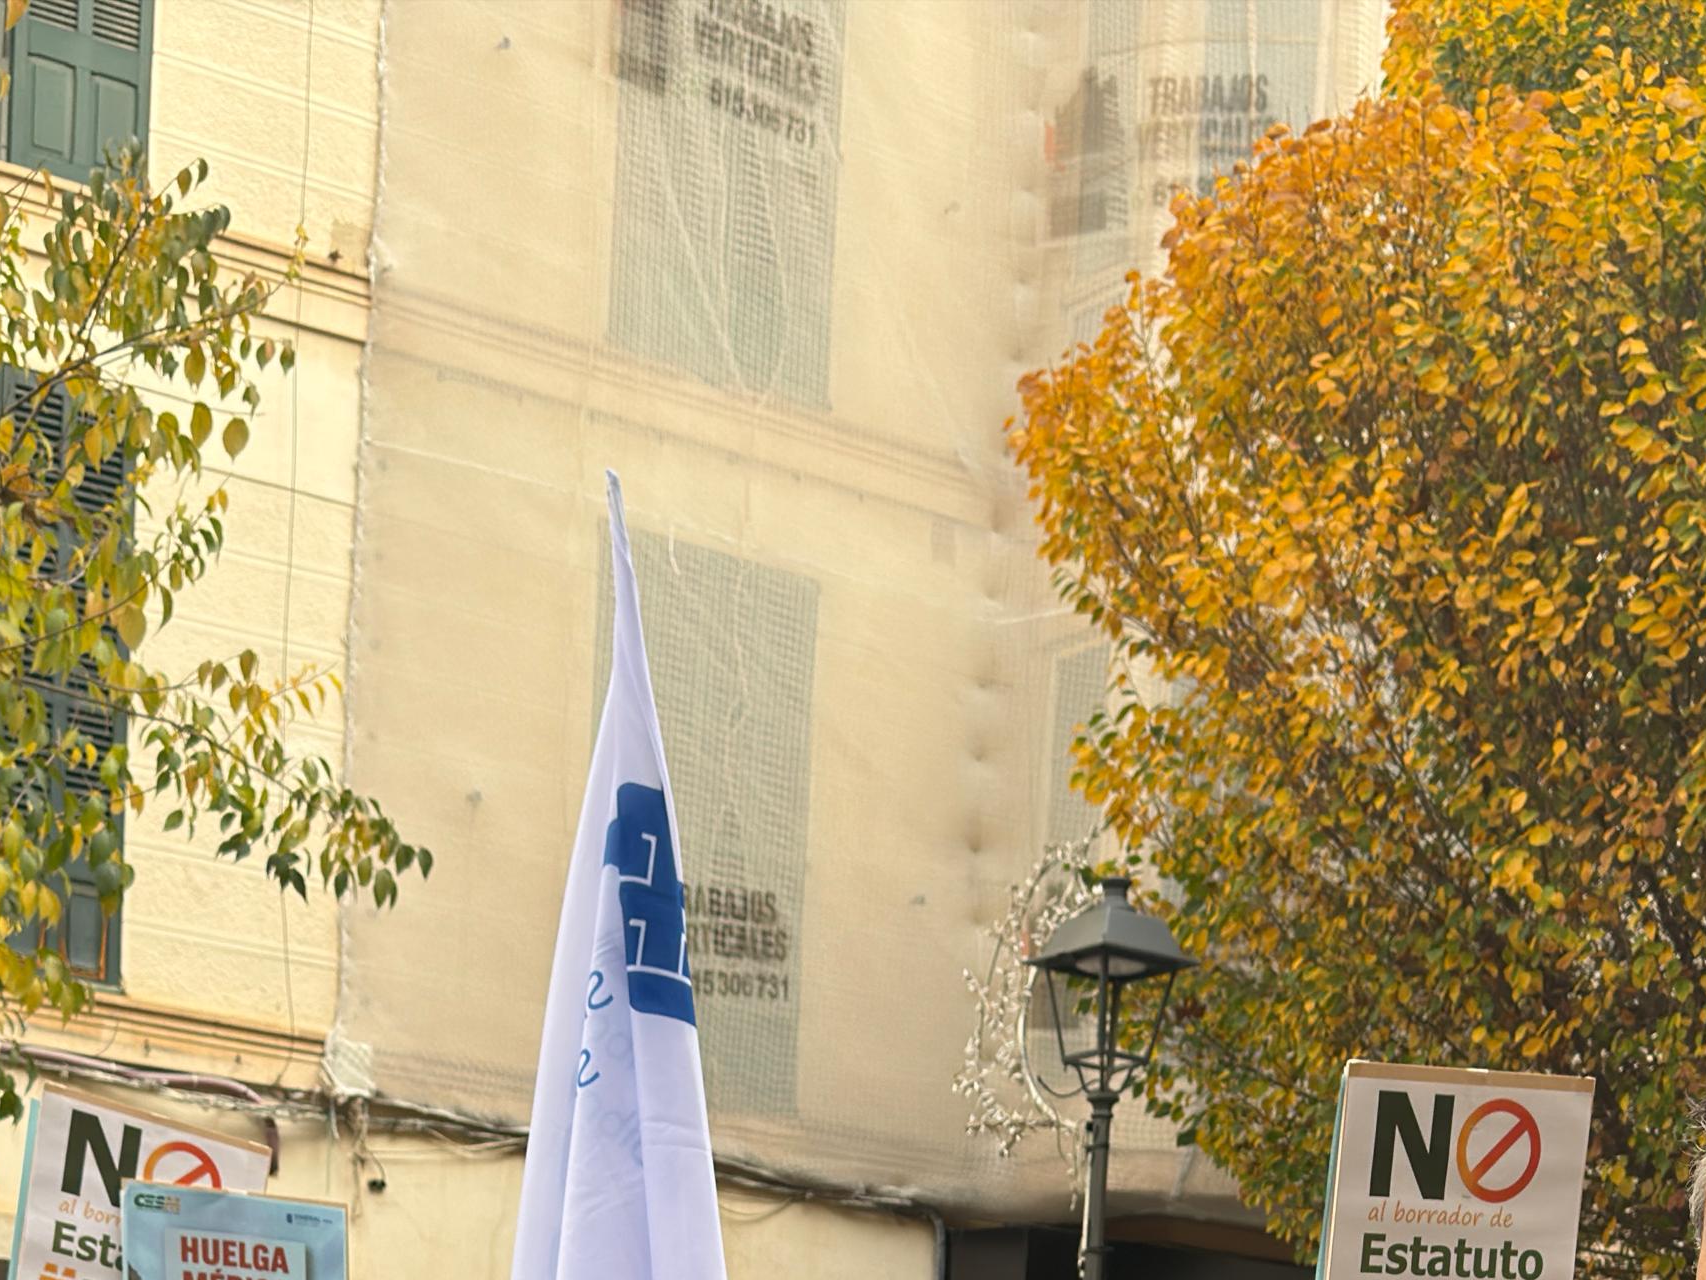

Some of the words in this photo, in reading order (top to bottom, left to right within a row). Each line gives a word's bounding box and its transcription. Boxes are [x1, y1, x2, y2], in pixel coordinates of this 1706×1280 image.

[691, 969, 790, 1002] 15306731
[1368, 1202, 1386, 1222] al
[1394, 1203, 1483, 1227] borrador
[1490, 1207, 1513, 1228] de
[180, 1235, 290, 1275] HUELGA
[1360, 1232, 1544, 1280] Estatuto
